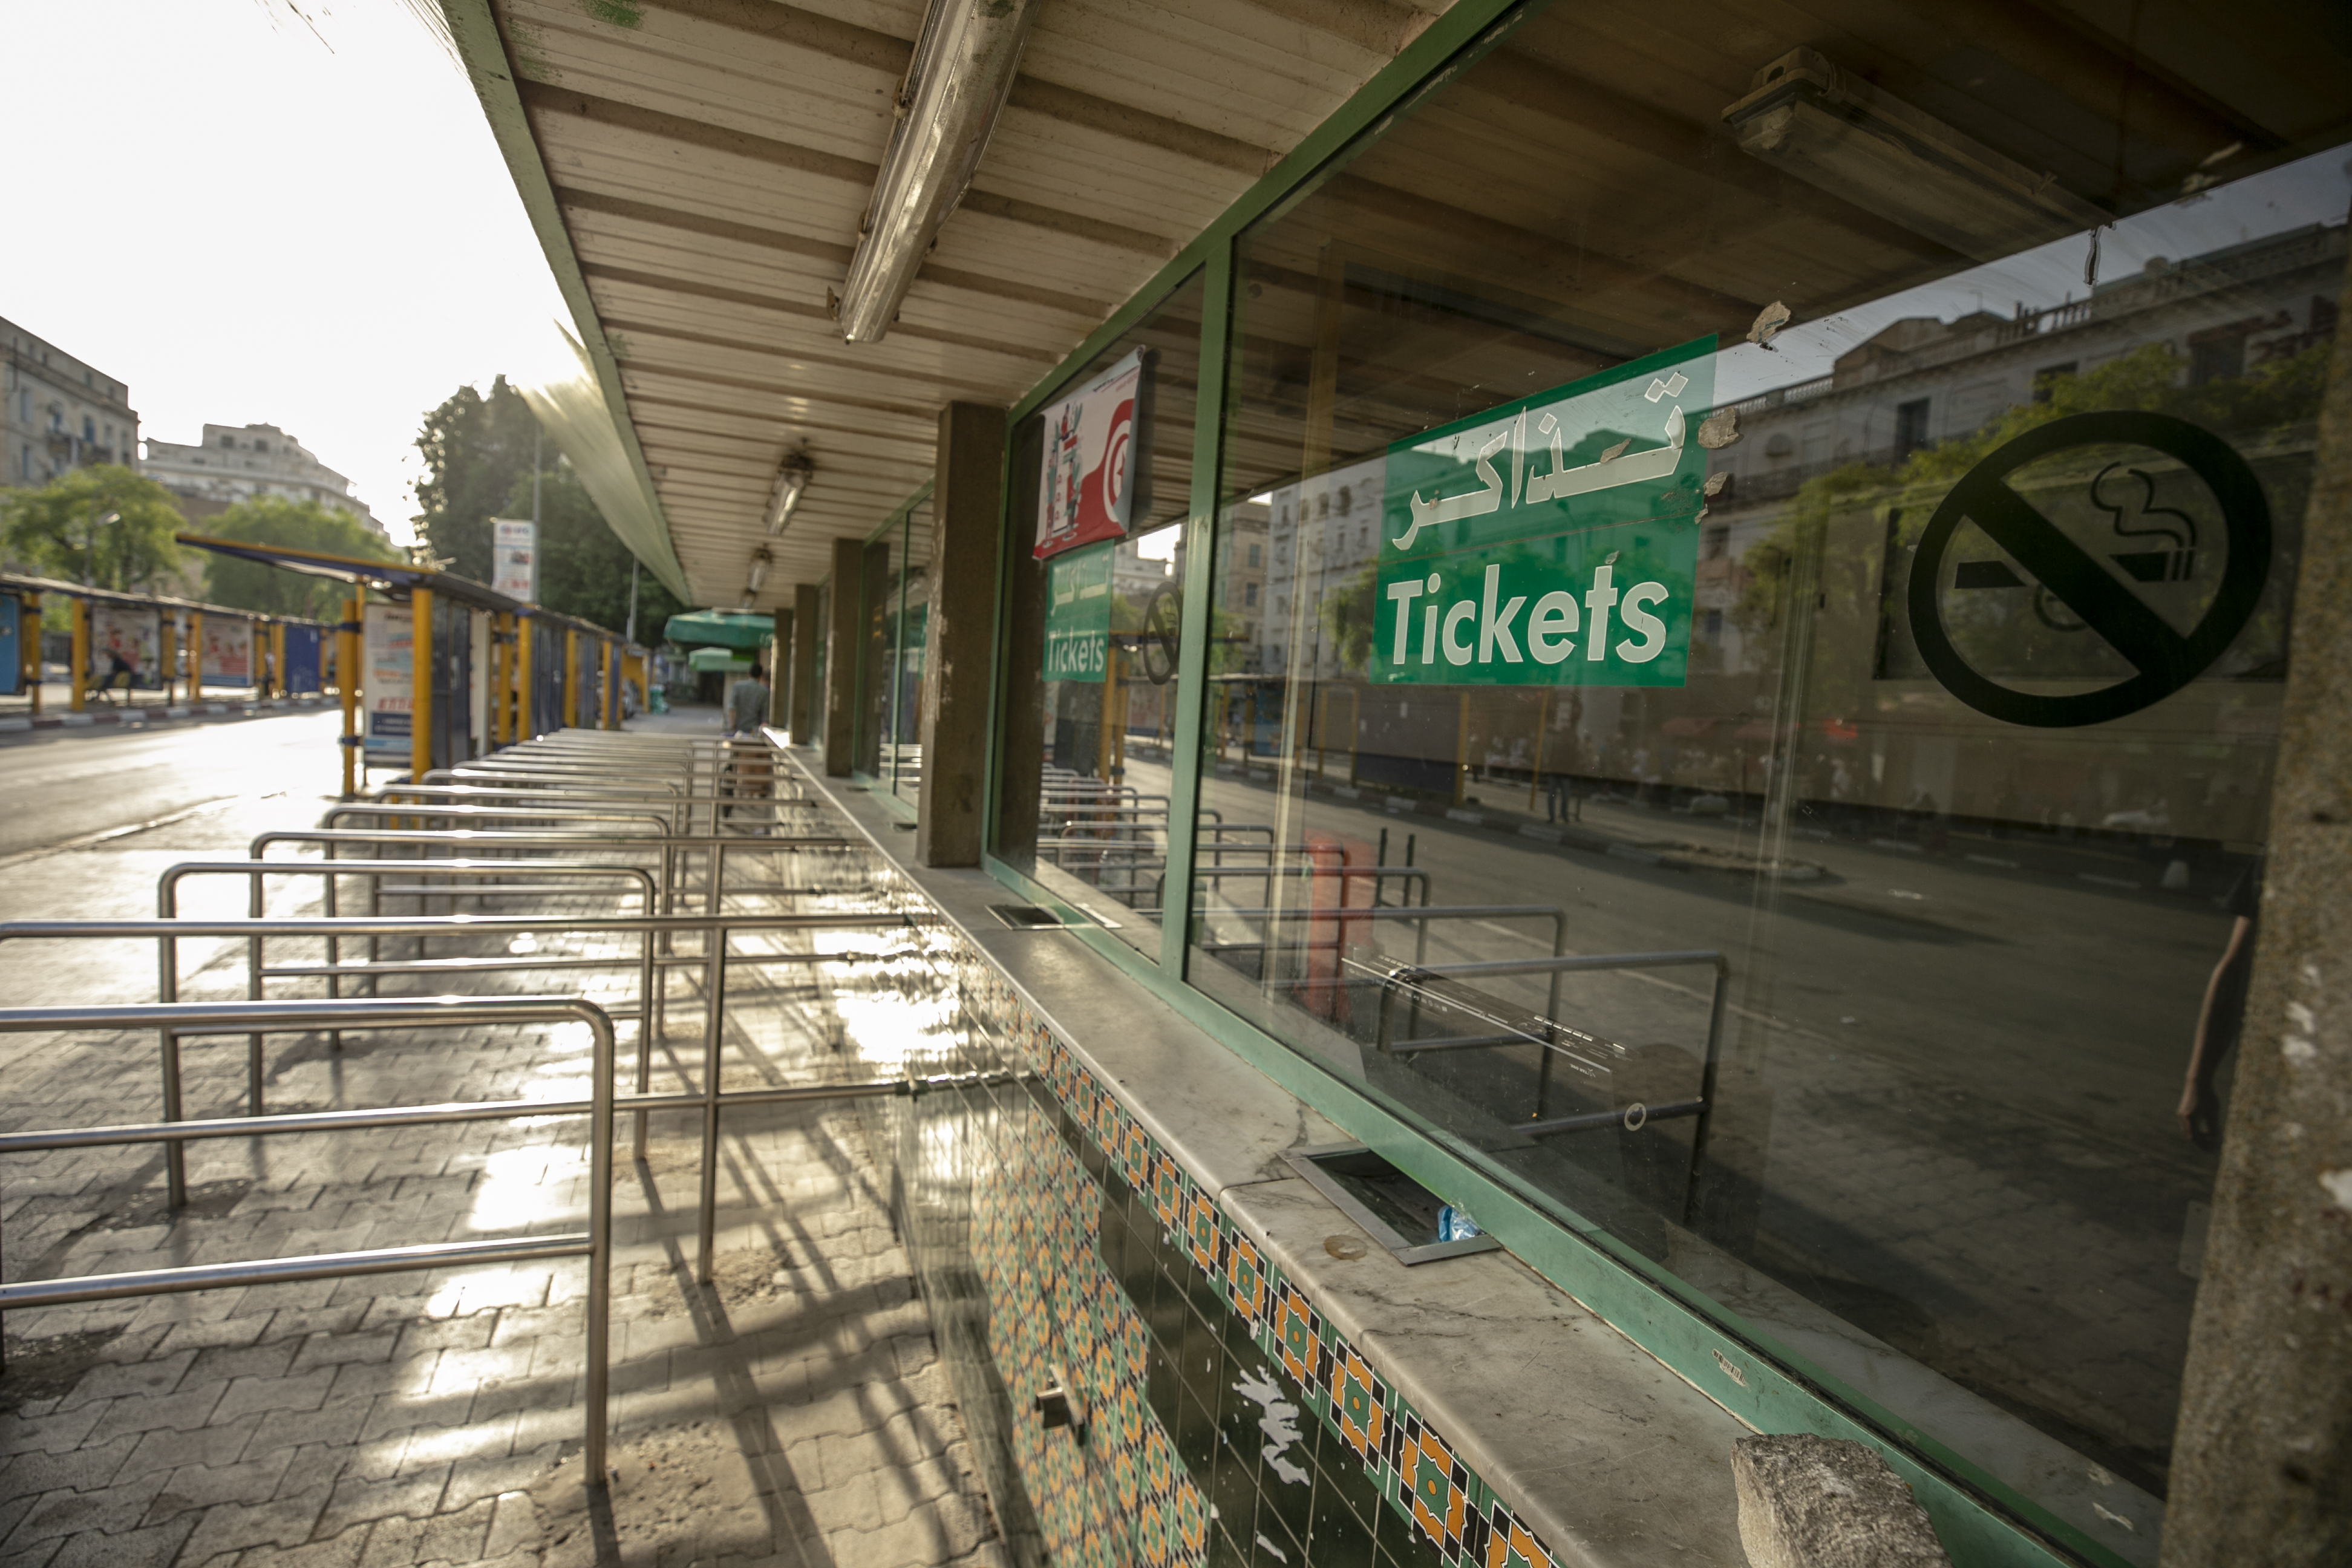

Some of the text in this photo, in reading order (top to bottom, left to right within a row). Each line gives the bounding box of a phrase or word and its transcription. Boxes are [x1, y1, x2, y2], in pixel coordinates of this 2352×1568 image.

[1391, 371, 1689, 551] تذاكر
[1047, 626, 1105, 673] Tickets
[1387, 563, 1670, 666] Tickets
